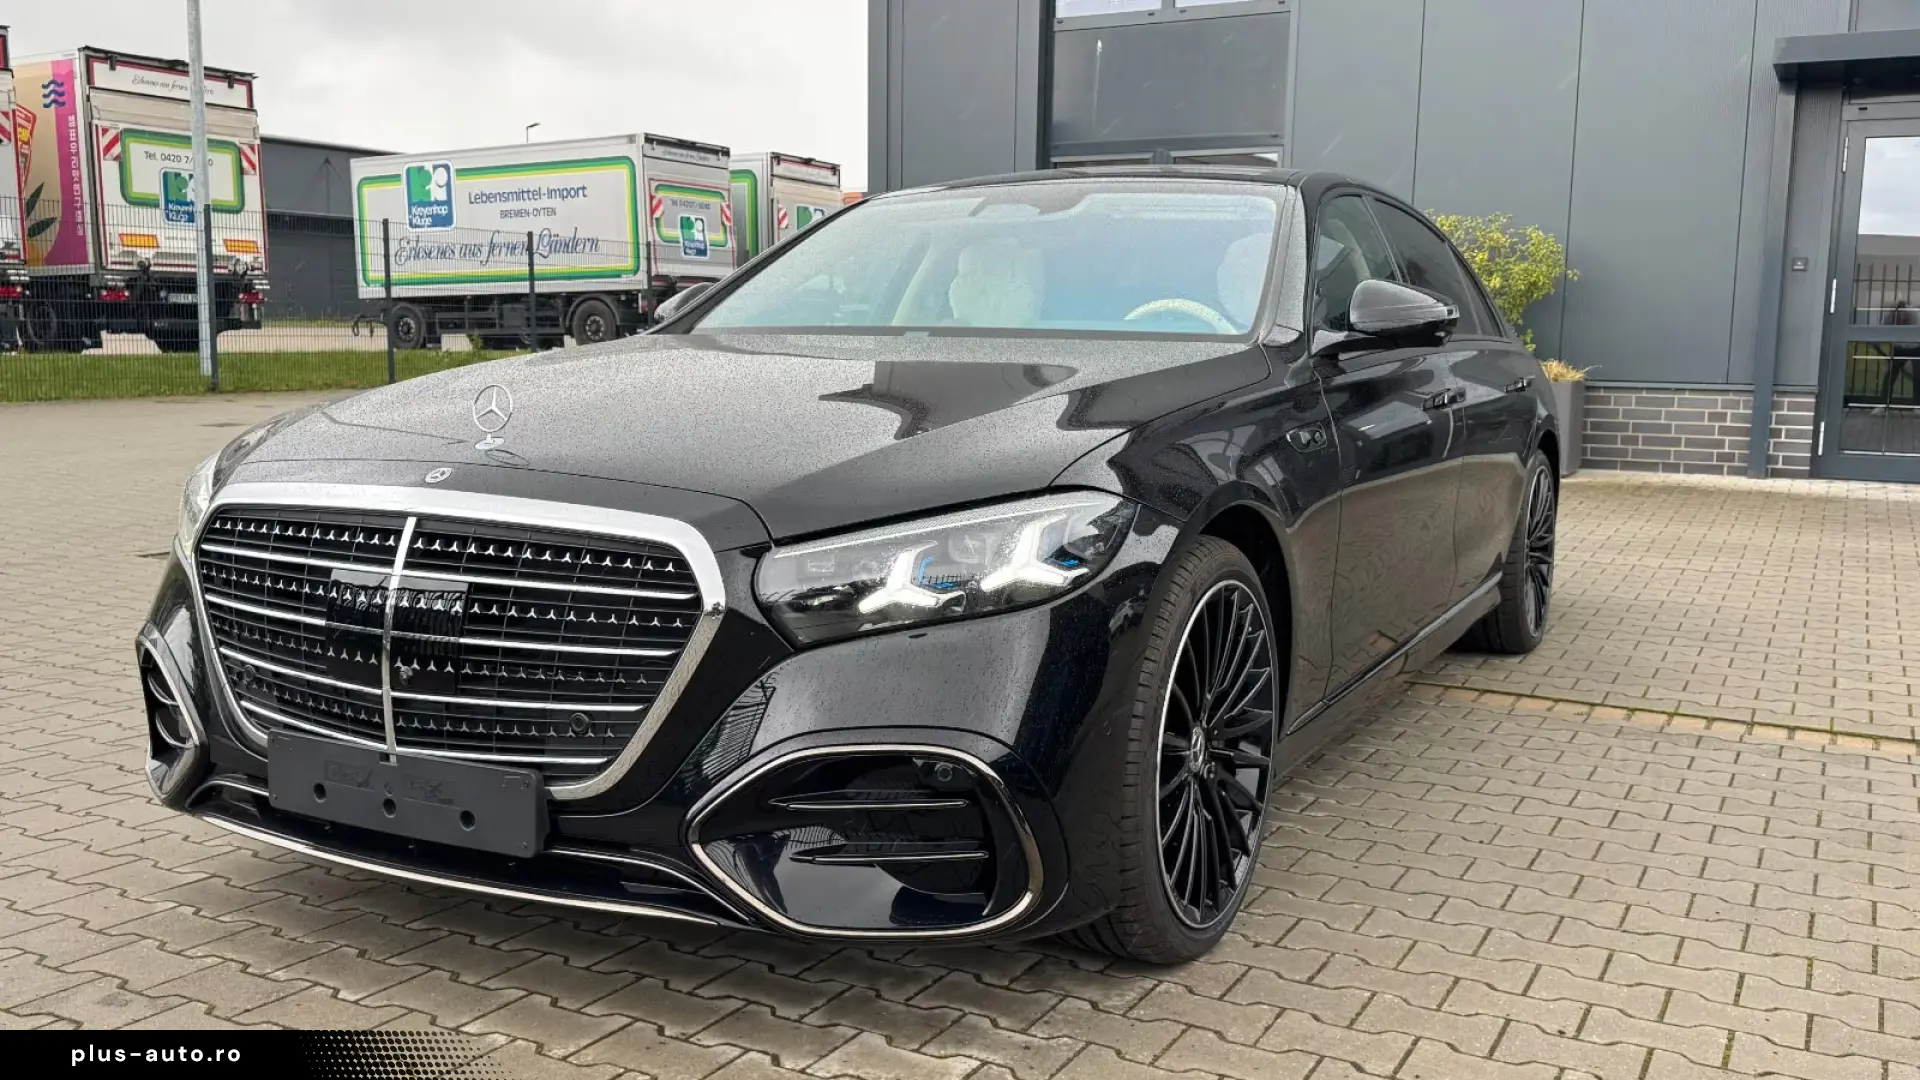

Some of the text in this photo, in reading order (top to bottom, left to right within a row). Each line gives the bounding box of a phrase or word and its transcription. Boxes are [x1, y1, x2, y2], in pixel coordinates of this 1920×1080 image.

[144, 151, 158, 161] Tel.
[161, 153, 182, 163] 0420
[468, 184, 588, 205] Lebensmittel-Import
[500, 207, 557, 219] BREMEN-OYTEN
[395, 226, 601, 266] Erlesenes aus fernen Ländern
